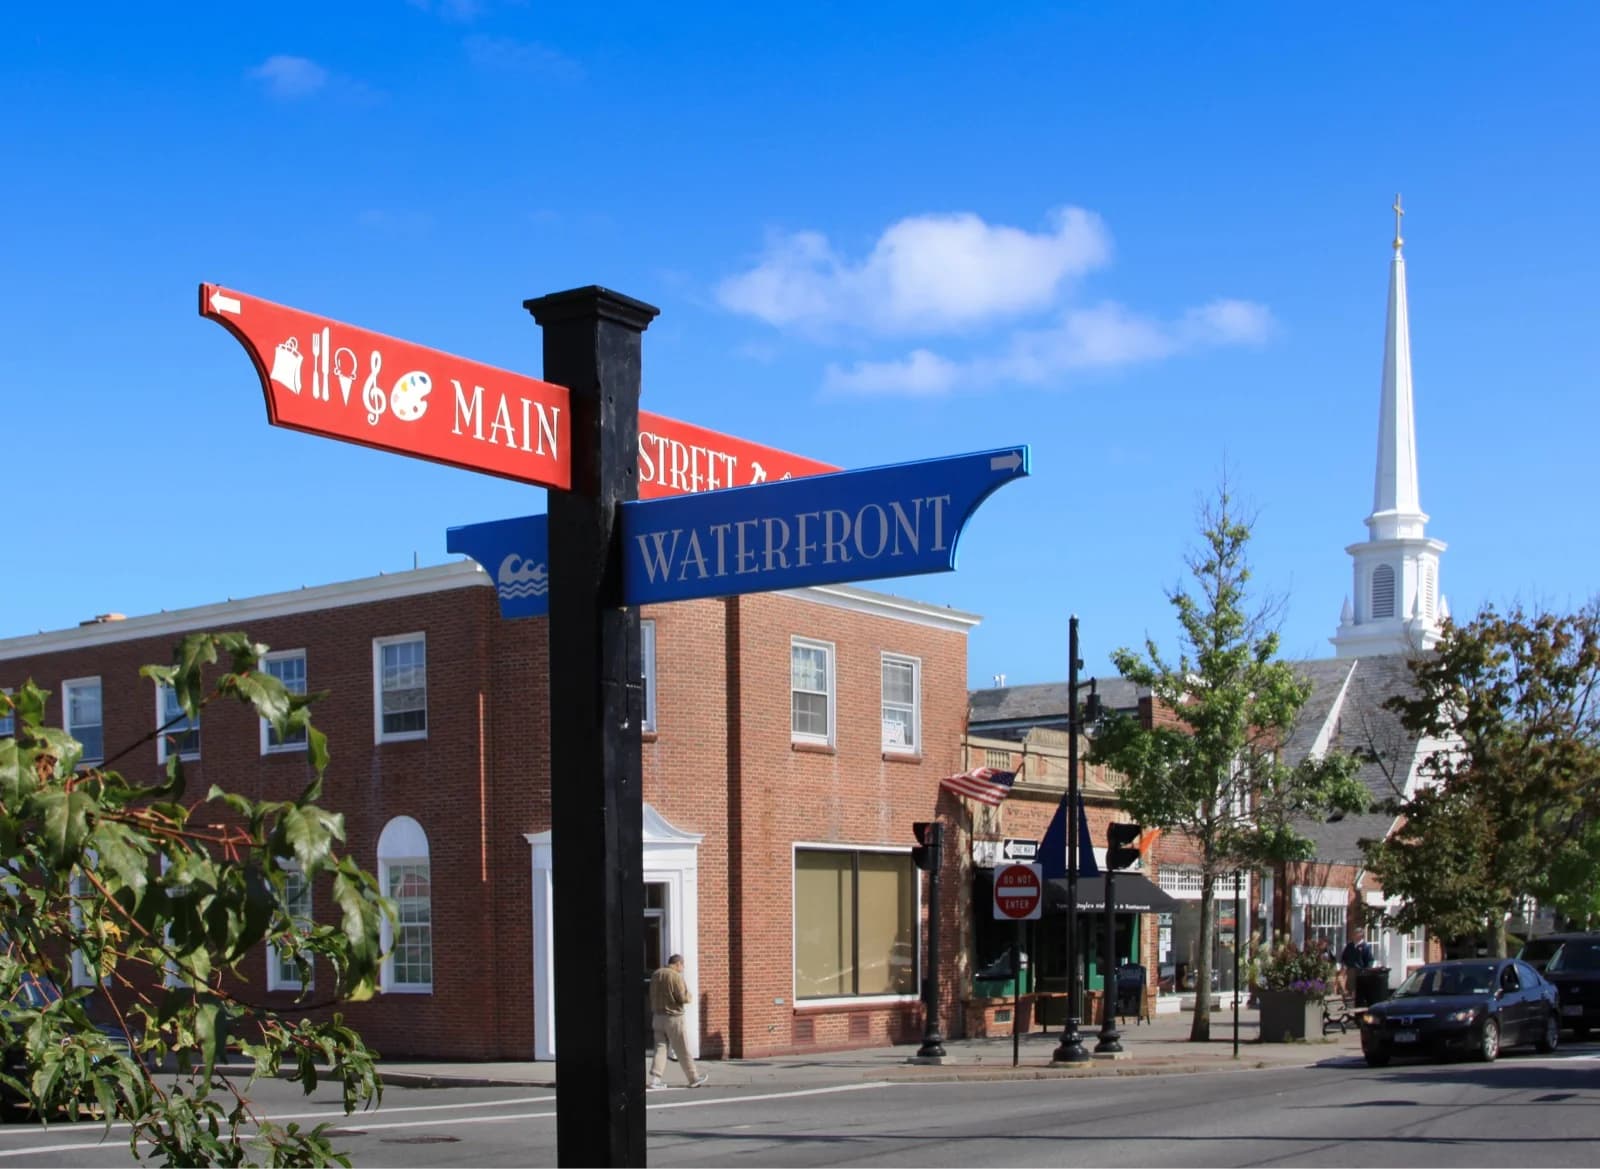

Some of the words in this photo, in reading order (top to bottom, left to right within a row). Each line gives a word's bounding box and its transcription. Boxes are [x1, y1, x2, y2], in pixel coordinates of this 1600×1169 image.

[450, 379, 560, 461] MAIN
[638, 431, 736, 493] STREET
[635, 494, 951, 585] WATERFRONT
[1024, 846, 1035, 855] WAY
[1003, 875, 1014, 884] DO
[1017, 875, 1031, 884] NOT
[1005, 900, 1030, 909] ENTER
